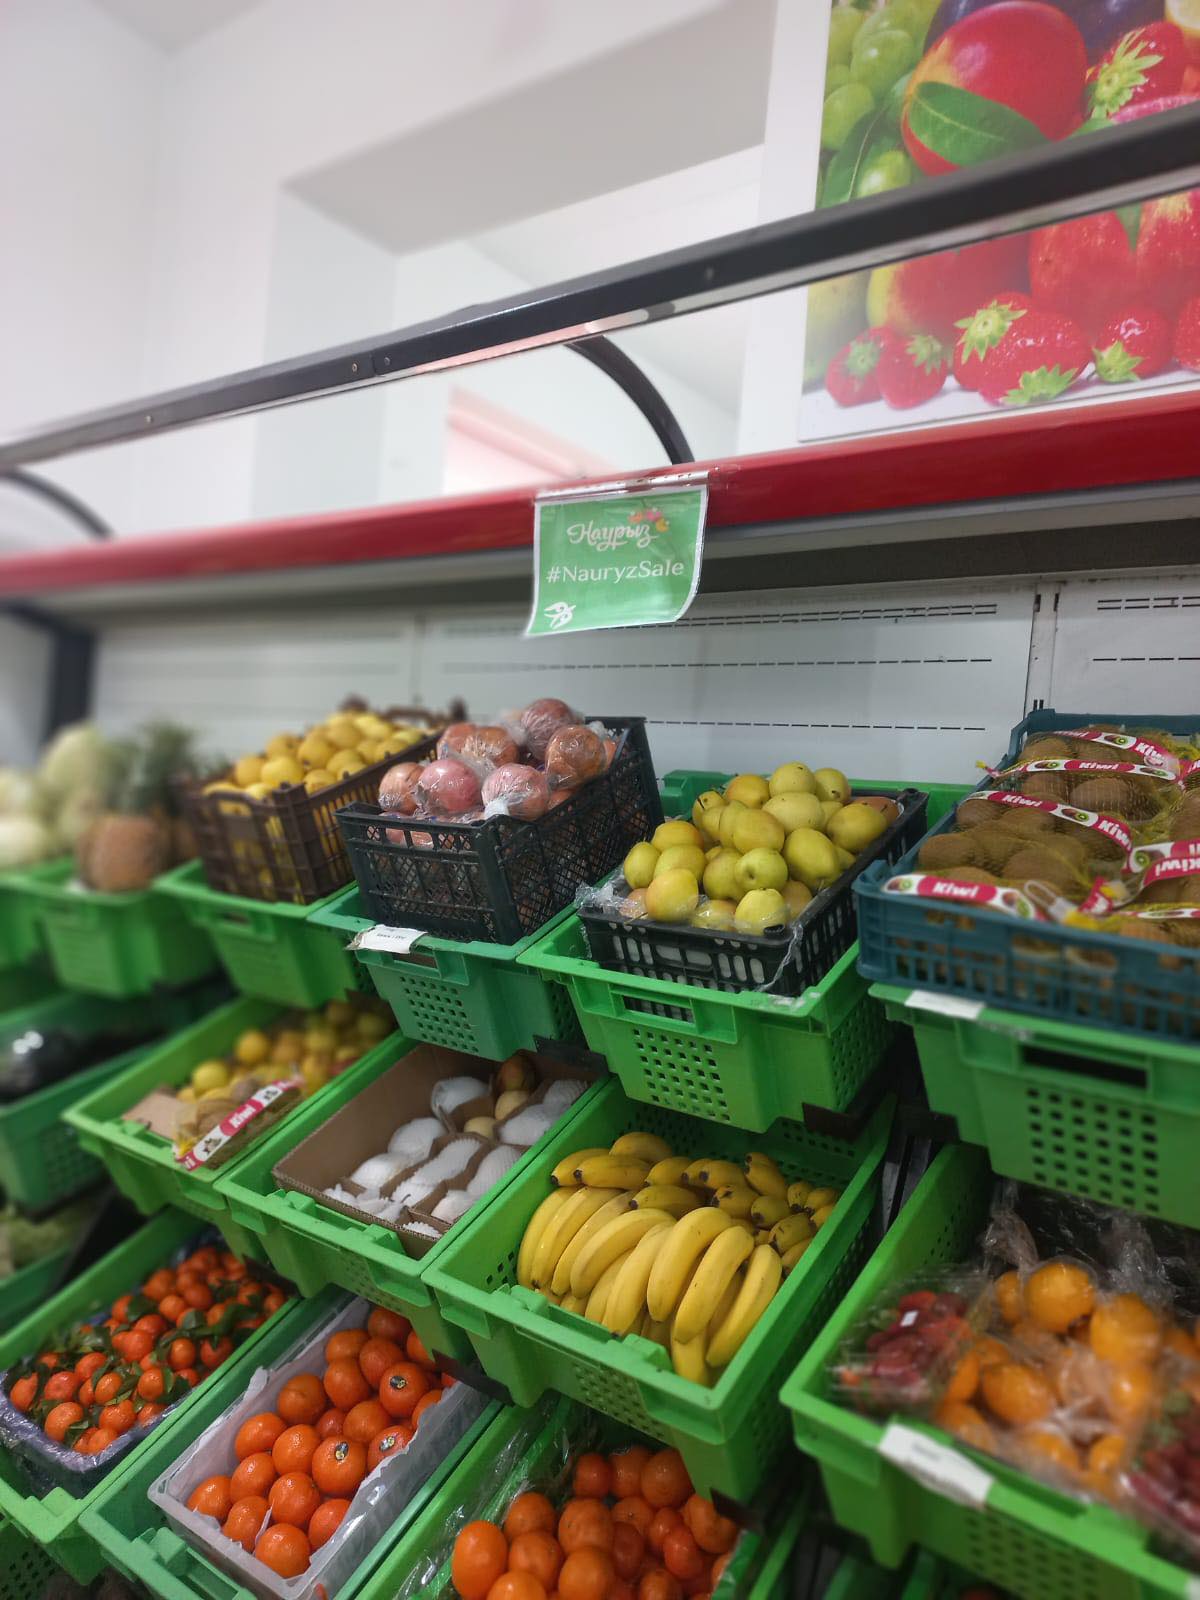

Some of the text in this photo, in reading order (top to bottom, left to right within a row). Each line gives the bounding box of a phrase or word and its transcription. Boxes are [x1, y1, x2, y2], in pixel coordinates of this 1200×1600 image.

[566, 520, 659, 551] Наурыз
[546, 560, 684, 583] #NauryzSale
[1079, 762, 1119, 770] Kiwi
[1002, 794, 1043, 807] Kiwi
[932, 881, 979, 898] Kiwi
[228, 1103, 257, 1129] Kiwi
